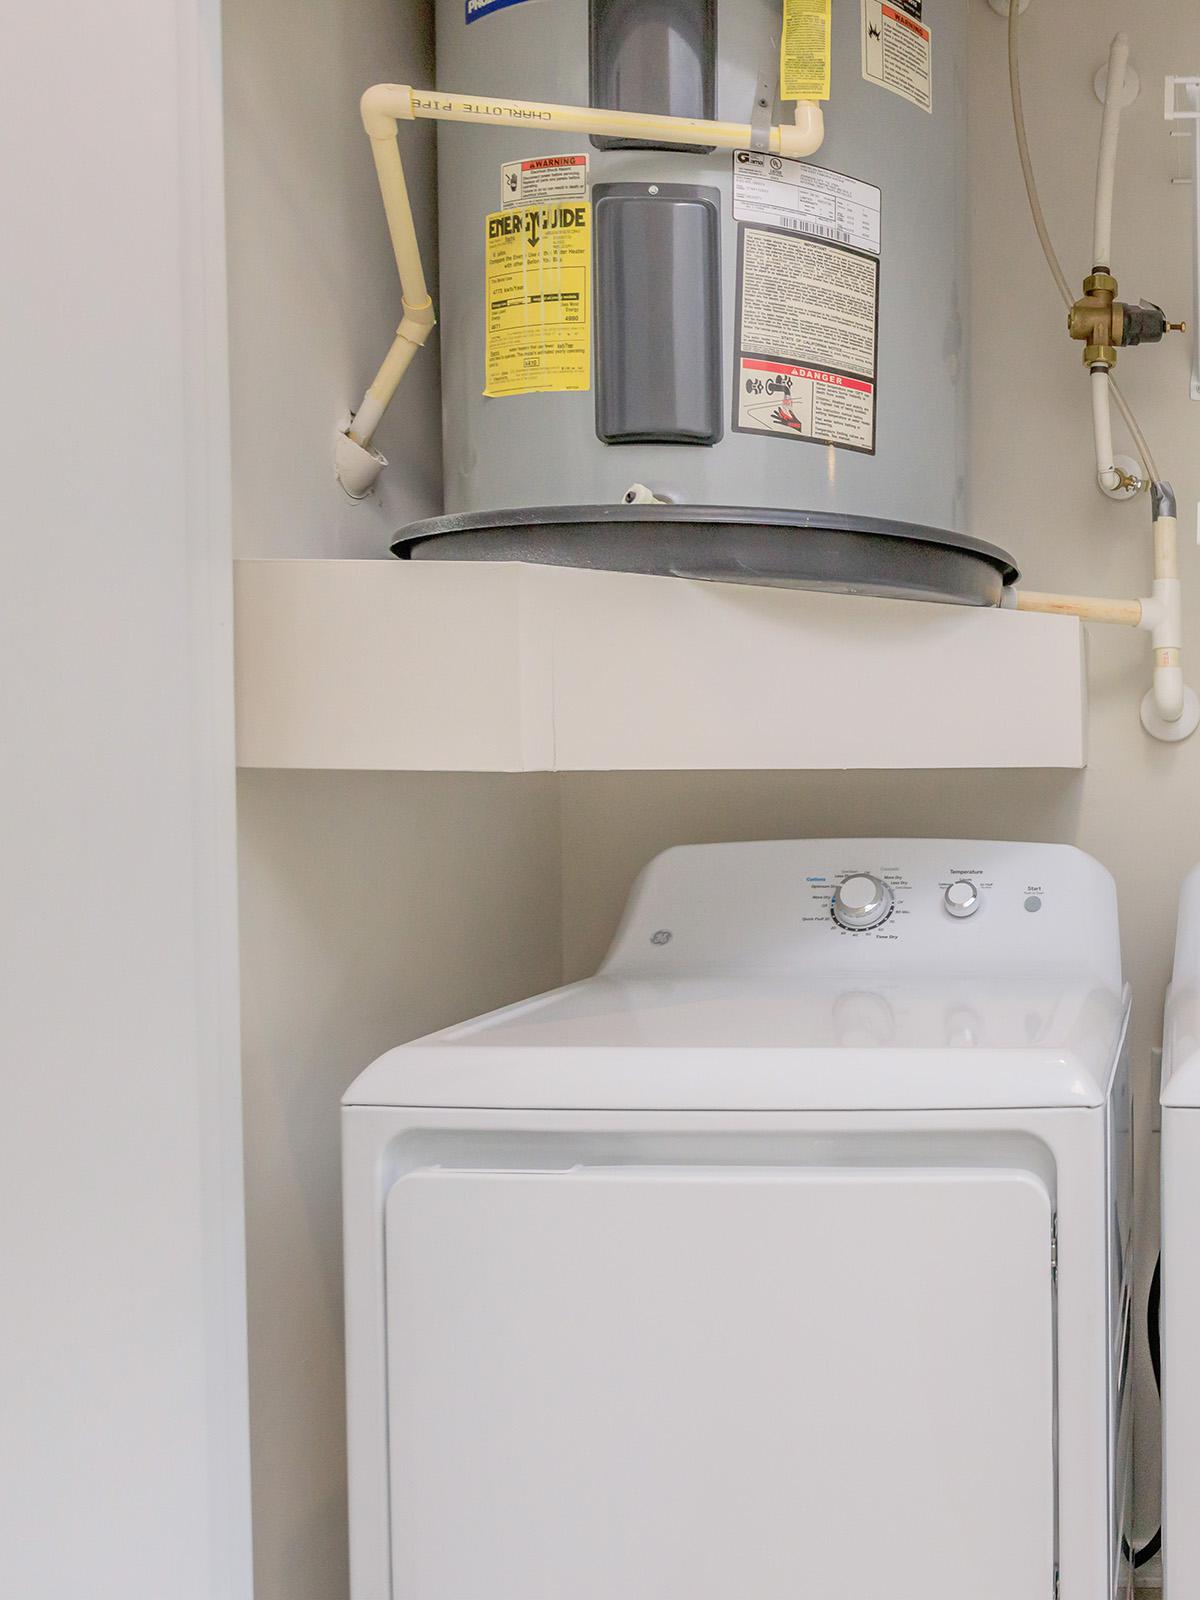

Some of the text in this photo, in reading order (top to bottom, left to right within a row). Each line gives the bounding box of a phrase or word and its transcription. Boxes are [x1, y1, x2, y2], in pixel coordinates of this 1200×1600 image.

[412, 98, 552, 120] CHARLOTTE PIPE
[535, 157, 576, 167] WARNING
[800, 370, 843, 384] DANGER
